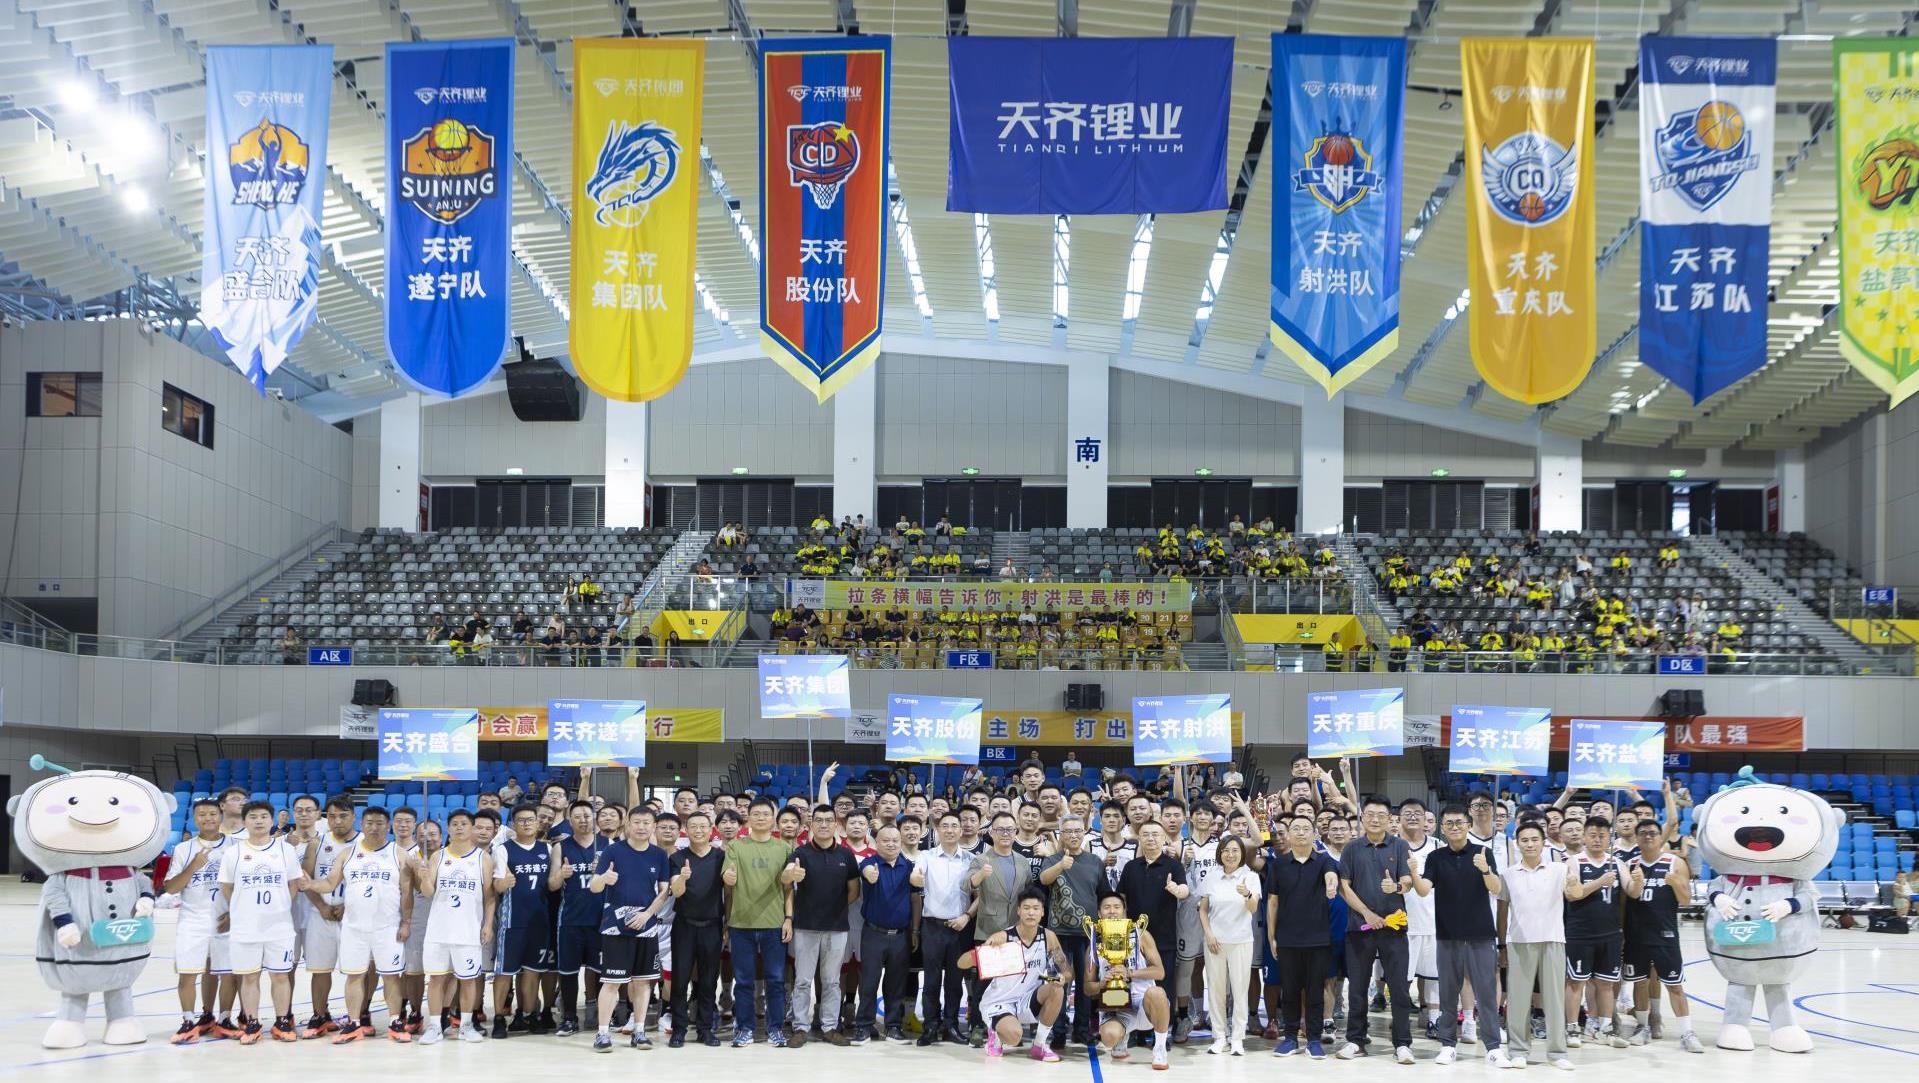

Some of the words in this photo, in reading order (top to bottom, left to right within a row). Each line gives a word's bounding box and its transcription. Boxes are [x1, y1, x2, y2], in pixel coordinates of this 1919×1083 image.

[997, 102, 1183, 141] 天齐锂业
[800, 142, 839, 167] CD
[998, 144, 1079, 154] TIANQI
[1095, 144, 1184, 154] LITHIUM
[237, 179, 277, 203] SHENG
[274, 180, 299, 203] HE
[401, 174, 495, 198] SUINING
[435, 201, 462, 211] ANJU
[233, 236, 291, 266] 天齐
[422, 235, 472, 264] 天齐
[799, 239, 848, 265] 天齐
[1313, 230, 1362, 258] 天齐
[602, 250, 658, 278] 天齐
[1506, 251, 1559, 281] 天齐
[1670, 247, 1737, 275] 天齐
[222, 270, 301, 301] 盛合队
[408, 270, 486, 301] 遂宁队
[786, 276, 861, 304] 股份队
[1299, 267, 1375, 297] 射洪队
[591, 281, 668, 312] 集团队
[1493, 288, 1573, 317] 重庆队
[1654, 283, 1752, 315] 江苏队
[1075, 437, 1101, 462] 南
[319, 650, 341, 662] A区
[960, 653, 980, 666] F区
[1670, 659, 1694, 671] D区
[765, 675, 846, 695] 天齐集团
[553, 721, 641, 742] 天齐遂宁
[892, 715, 975, 740] 天齐股份
[988, 718, 1040, 740] 主场
[1076, 718, 1127, 740] 打出
[1138, 718, 1226, 741] 天齐射洪
[1313, 711, 1399, 734] 天齐重庆
[383, 732, 472, 754] 天齐盛合
[1456, 727, 1545, 751] 天齐江苏
[985, 747, 1006, 759] B区
[1575, 742, 1659, 765] 天齐盐亭
[515, 864, 548, 874] 天齐遂宁
[528, 875, 538, 890] 7
[208, 888, 219, 901] 7
[256, 890, 271, 905] 10
[450, 894, 461, 907] 3
[1178, 939, 1186, 951] 9
[466, 958, 475, 970] 3
[1576, 960, 1582, 973] 1
